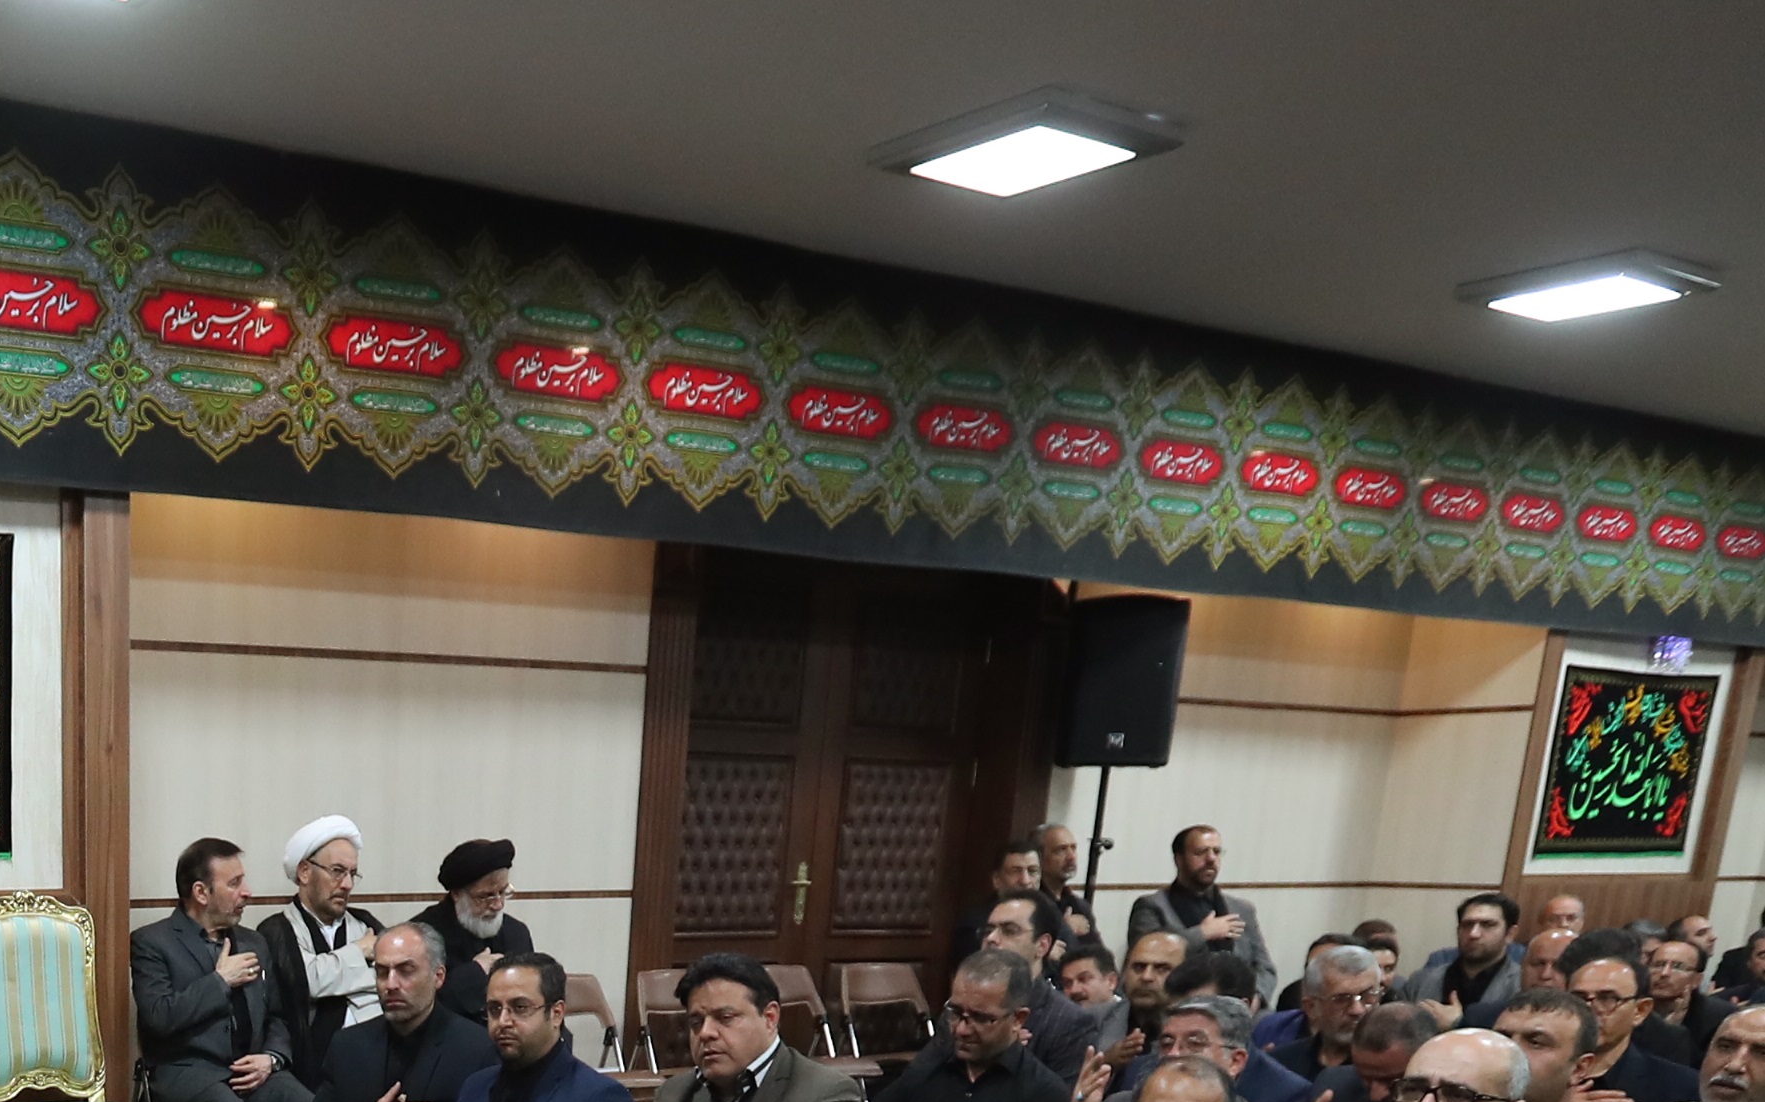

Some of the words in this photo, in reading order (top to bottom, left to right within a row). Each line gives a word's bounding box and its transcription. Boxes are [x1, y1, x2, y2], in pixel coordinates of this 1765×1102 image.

[26, 300, 41, 323] بر
[43, 295, 78, 329] سلام
[162, 300, 198, 341] مظلوم
[226, 323, 239, 346] بر
[241, 318, 274, 351] سلام
[346, 325, 380, 365] مظلوم
[403, 346, 416, 368] بر
[417, 341, 447, 373] سلام
[512, 351, 543, 389] مظلوم
[576, 367, 605, 398] سلام
[663, 371, 693, 408] مظلوم
[722, 387, 749, 415] سلام
[801, 394, 829, 429] مظلوم
[855, 408, 880, 436] سلام
